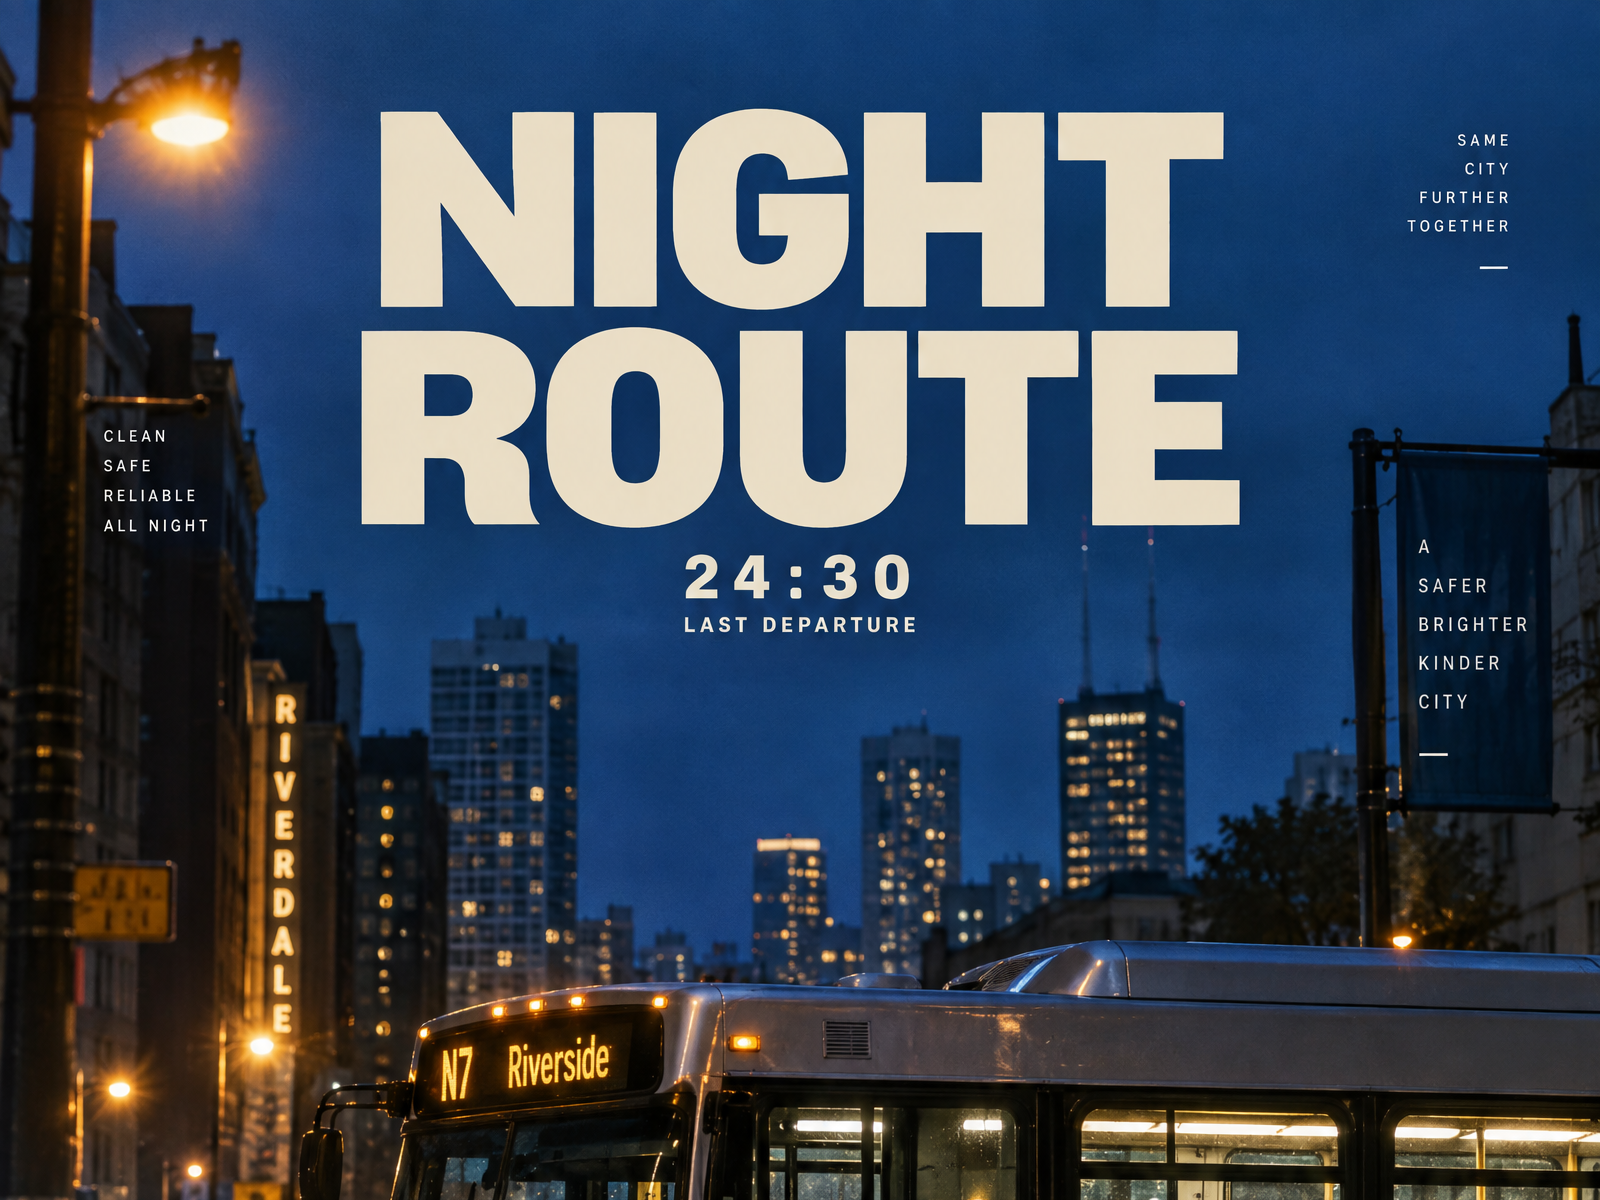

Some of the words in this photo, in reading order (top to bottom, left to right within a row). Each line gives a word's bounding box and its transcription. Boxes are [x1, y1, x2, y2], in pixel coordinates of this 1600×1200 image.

[1418, 539, 1430, 554] A
[1418, 577, 1487, 593] SAFER
[1418, 616, 1528, 632] BRIGHTER
[1418, 655, 1500, 671] KINDER
[1418, 693, 1469, 710] CITY
[271, 693, 297, 1033] RIVERDALE
[441, 1046, 473, 1101] N7
[508, 1034, 609, 1088] Riverside
